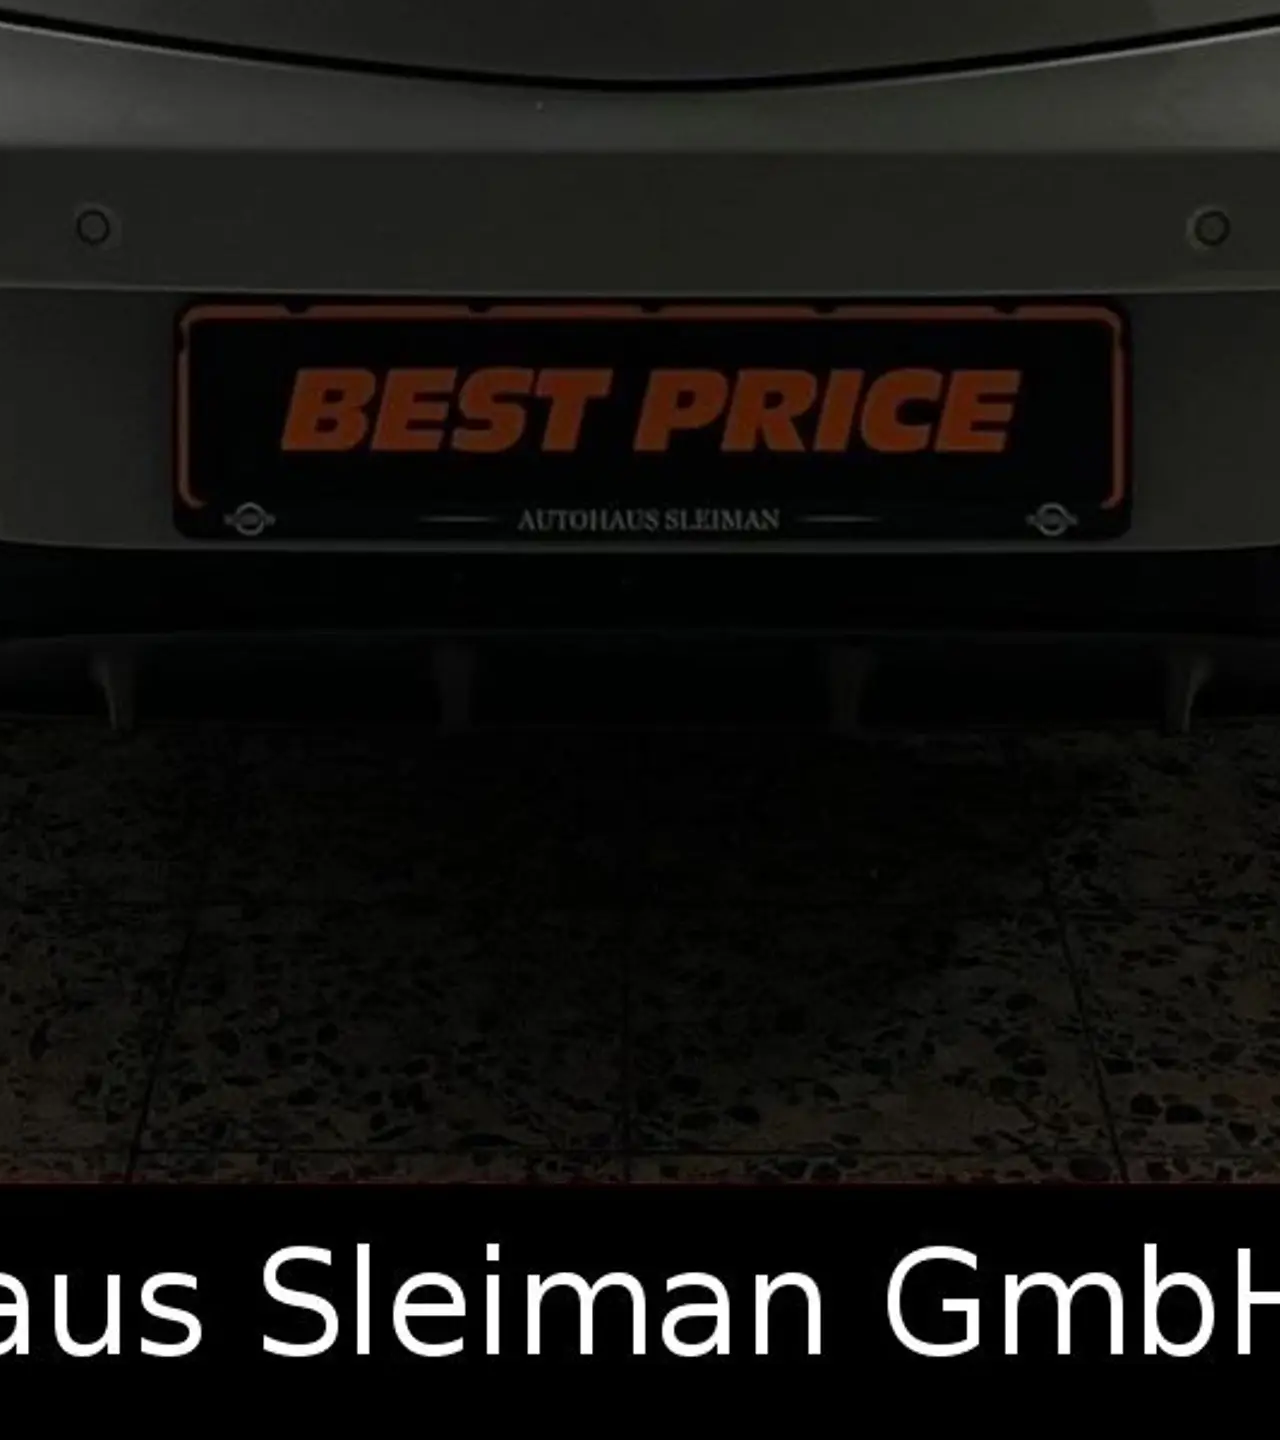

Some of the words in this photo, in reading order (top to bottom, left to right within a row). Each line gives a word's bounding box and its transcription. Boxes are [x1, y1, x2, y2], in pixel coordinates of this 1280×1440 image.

[281, 367, 612, 453] BEST
[634, 367, 1020, 453] PRICE
[516, 509, 661, 532] AUTOHAUS
[664, 508, 781, 532] SLEIMAN
